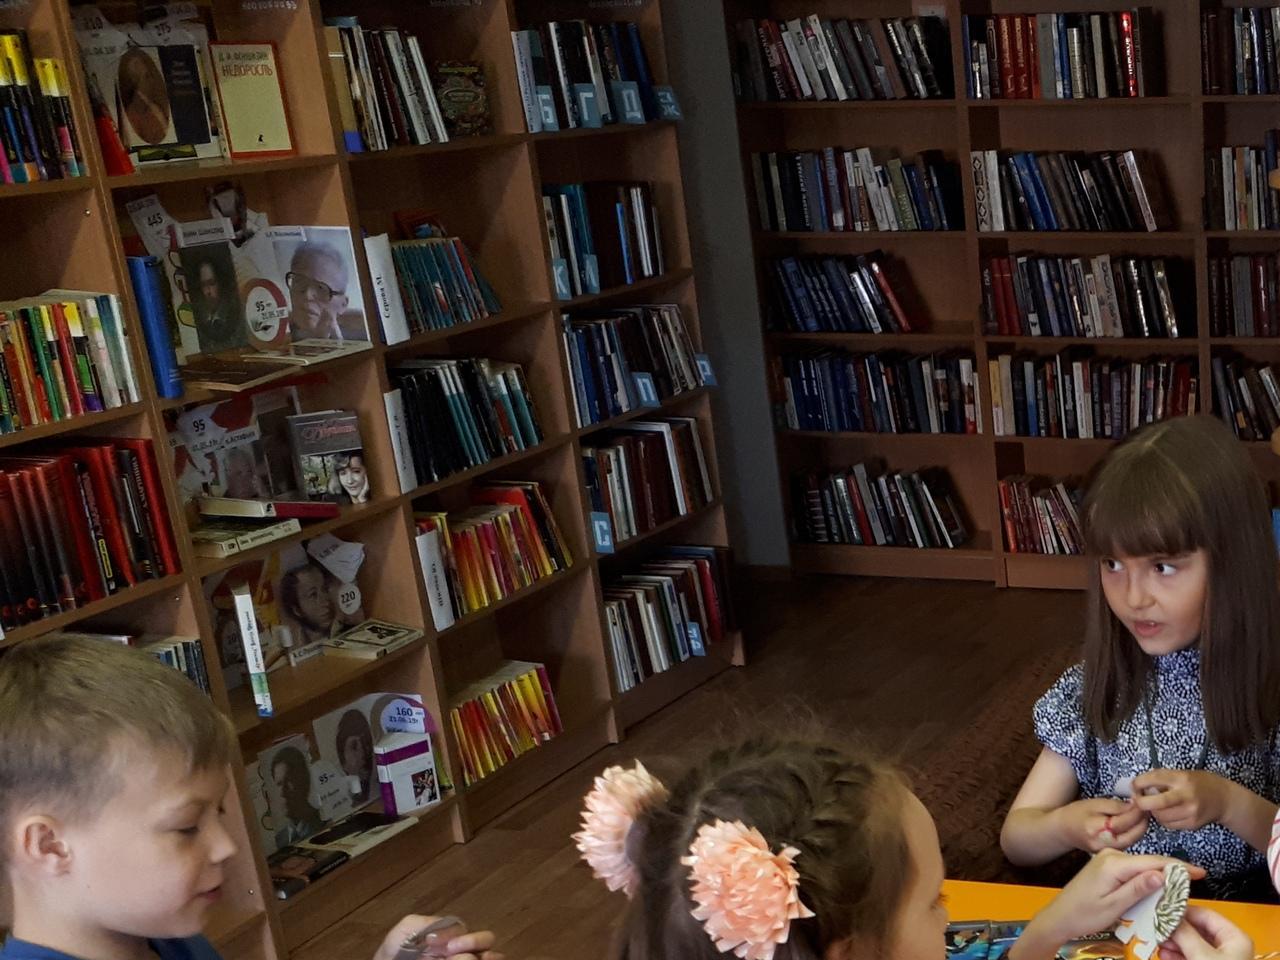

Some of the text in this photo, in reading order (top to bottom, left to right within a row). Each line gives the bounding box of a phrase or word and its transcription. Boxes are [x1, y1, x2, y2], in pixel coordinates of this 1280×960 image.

[538, 94, 554, 124] Б
[579, 92, 594, 120] Г
[622, 89, 642, 122] Д
[637, 378, 655, 402] П
[193, 419, 206, 433] 95
[594, 520, 610, 547] С
[339, 591, 356, 603] 220
[396, 707, 413, 717] 160
